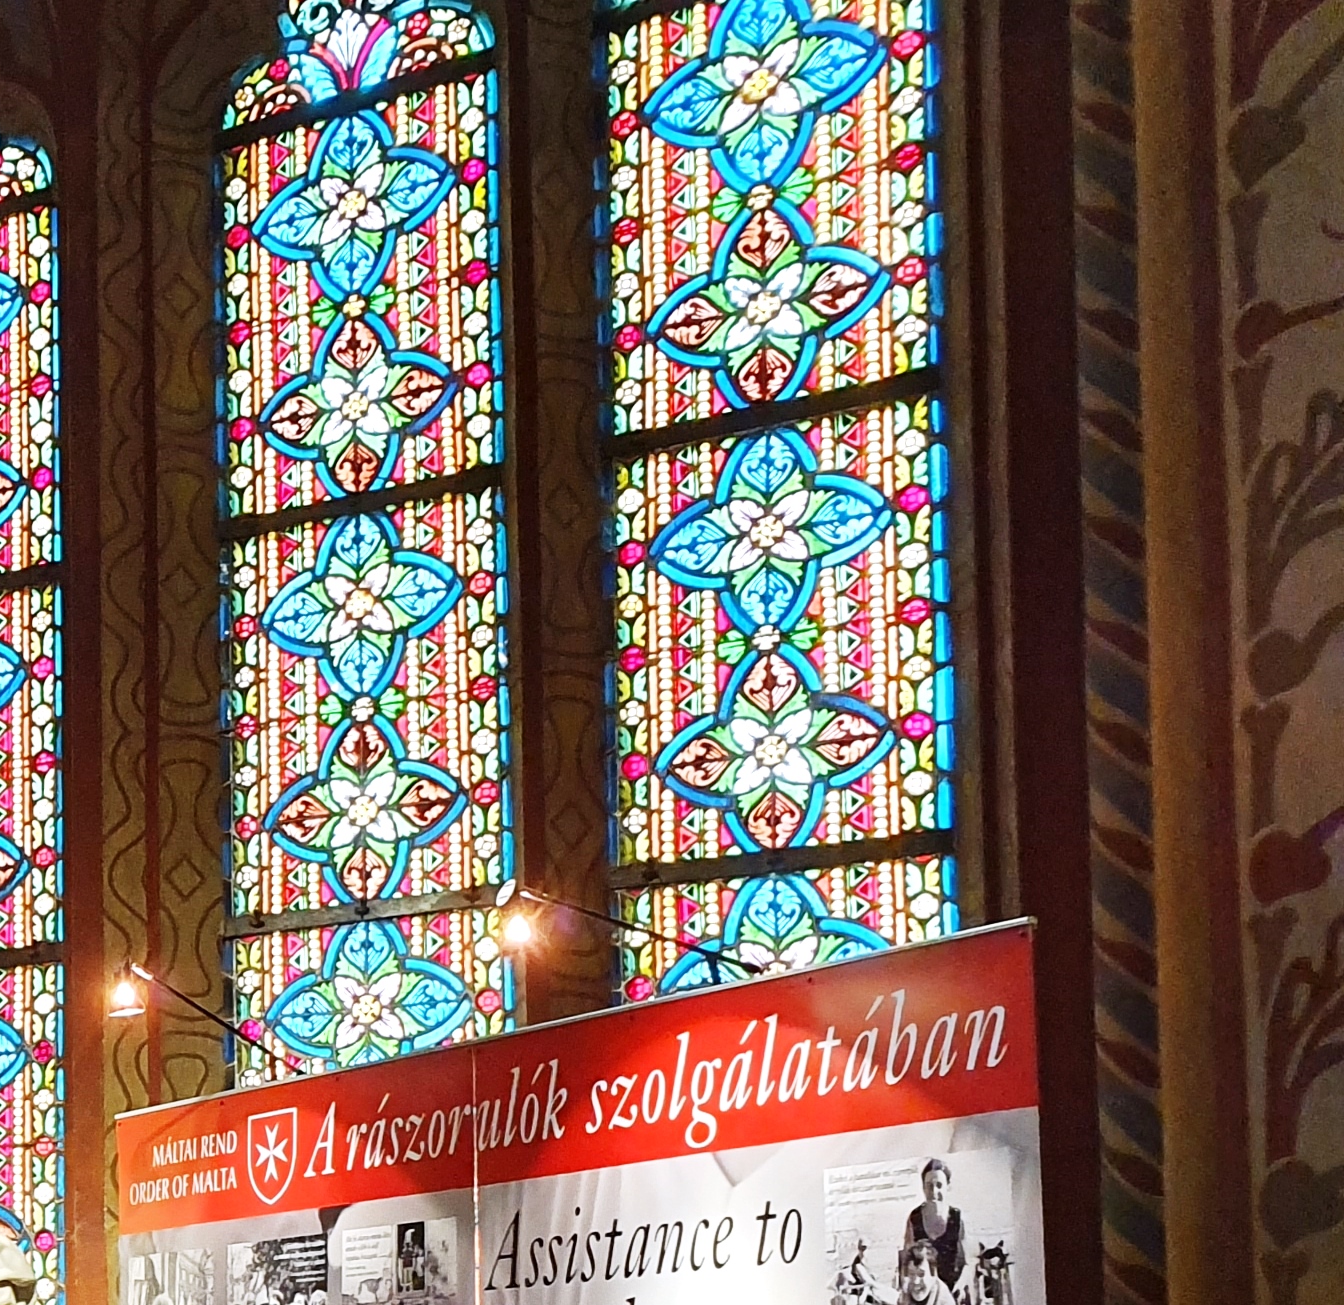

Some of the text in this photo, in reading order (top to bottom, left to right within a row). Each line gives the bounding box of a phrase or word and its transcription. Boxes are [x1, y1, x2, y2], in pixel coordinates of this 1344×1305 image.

[304, 988, 1009, 1178] A rászorulók szolgálatában
[152, 1130, 238, 1168] MÁLTAI REND
[129, 1168, 237, 1206] ORDER OF MALTA
[485, 1201, 804, 1292] Assistance to
